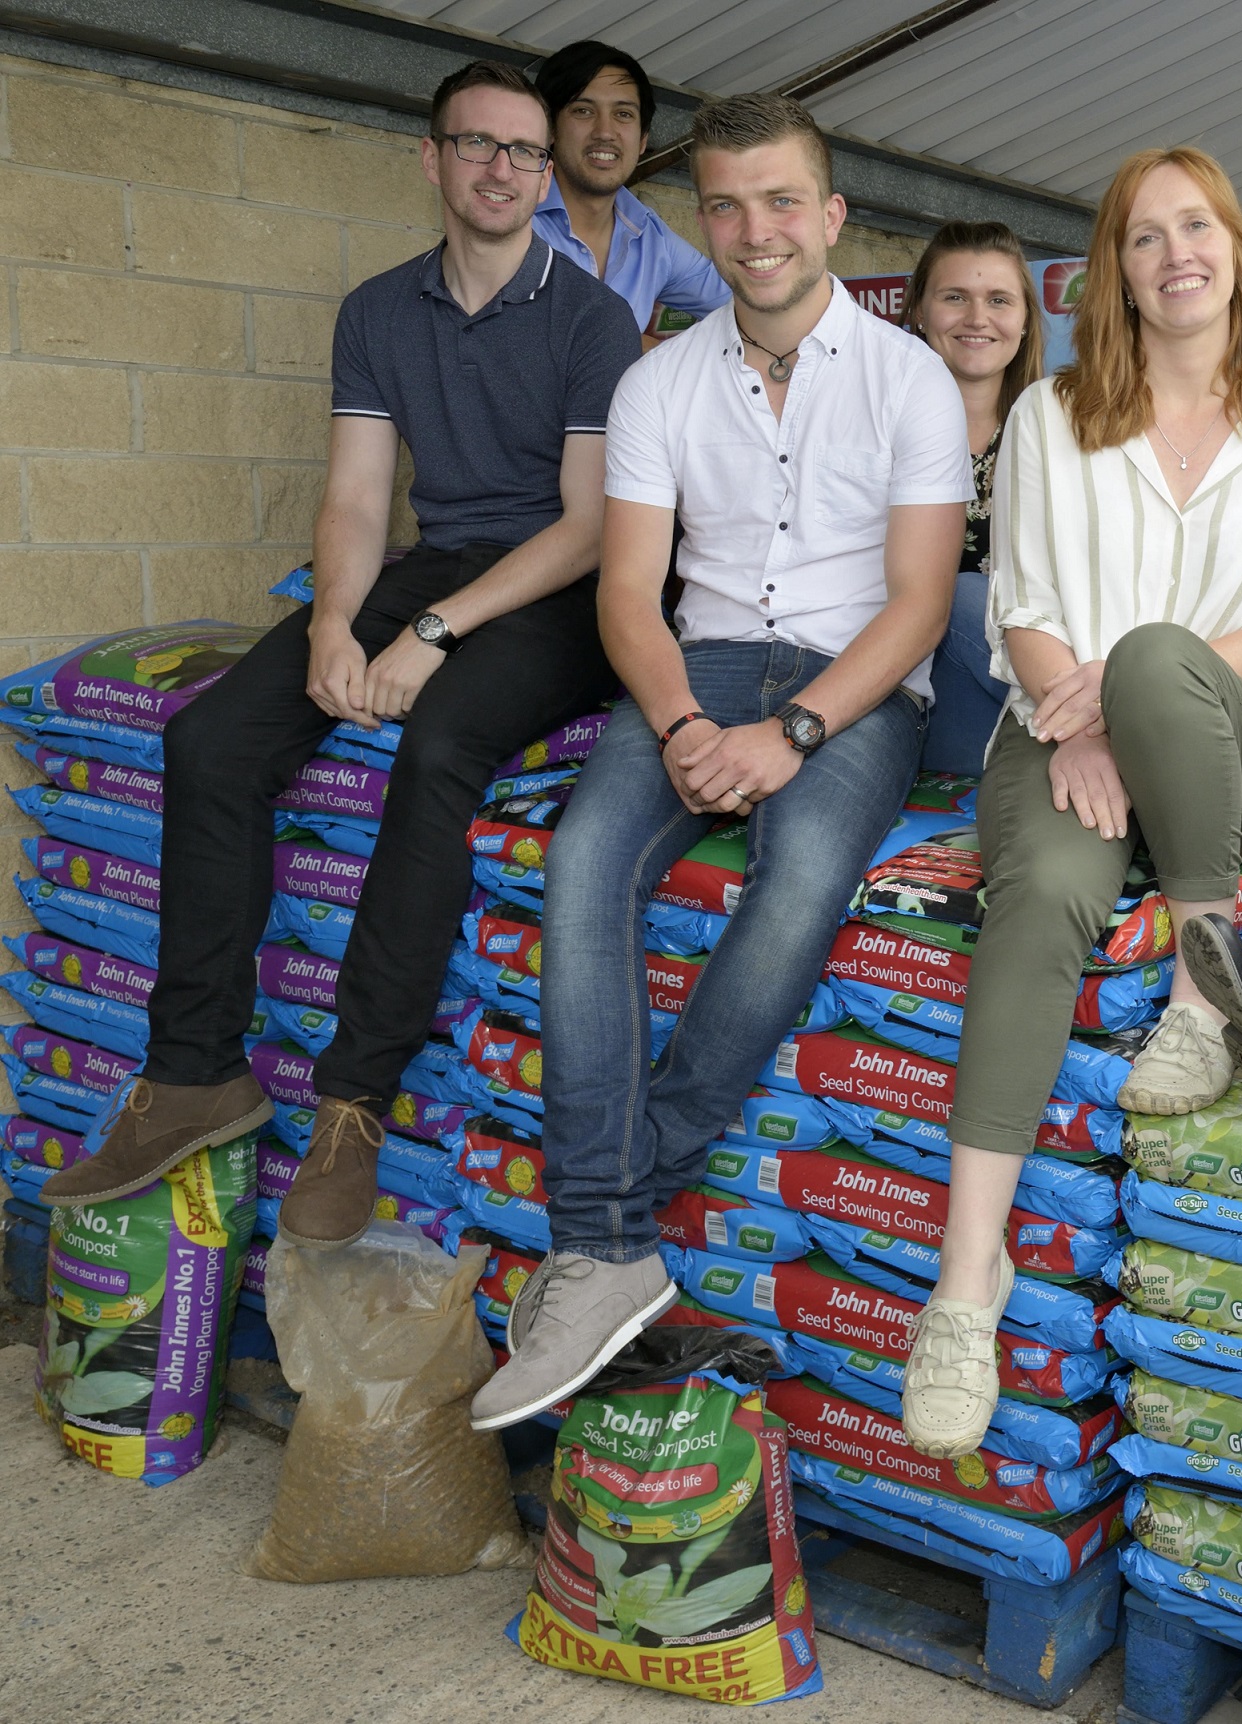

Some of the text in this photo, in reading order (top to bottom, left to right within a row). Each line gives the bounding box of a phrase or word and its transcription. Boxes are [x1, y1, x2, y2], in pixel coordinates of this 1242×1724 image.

[563, 724, 594, 745] John
[301, 764, 370, 790] Innes No.1
[300, 787, 375, 814] Plant Compost
[289, 852, 362, 879] John Innes
[285, 876, 349, 899] Young Plant
[852, 931, 897, 957] John
[898, 938, 953, 967] Innes
[283, 957, 315, 979] John
[927, 1005, 958, 1025] John
[84, 1053, 110, 1075] John
[273, 1058, 306, 1080] John
[849, 1049, 949, 1088] John Innes
[269, 1081, 302, 1104] Young
[819, 1072, 909, 1109] Seed Sowing
[261, 1157, 291, 1180] John
[833, 1166, 931, 1207] John Innes
[802, 1188, 891, 1228] Seed Sowing
[77, 1208, 130, 1236] No.1
[64, 1260, 126, 1288] best start in life
[1019, 1281, 1060, 1304] Compost
[162, 1248, 196, 1393] John Innes No.1
[797, 1307, 885, 1349] Seed Sowing
[189, 1308, 215, 1398] Young Plant
[1002, 1403, 1039, 1425] Compost
[1137, 1402, 1169, 1415] Super
[581, 1421, 619, 1455] Seed
[817, 1402, 911, 1447] John Innes
[787, 1421, 942, 1483] Seed Sowing Compost
[666, 1473, 703, 1491] to life
[872, 1477, 1026, 1542] John Innes Seed Sowing Compost
[528, 1598, 631, 1680] EXTRA
[639, 1645, 751, 1685] FREE
